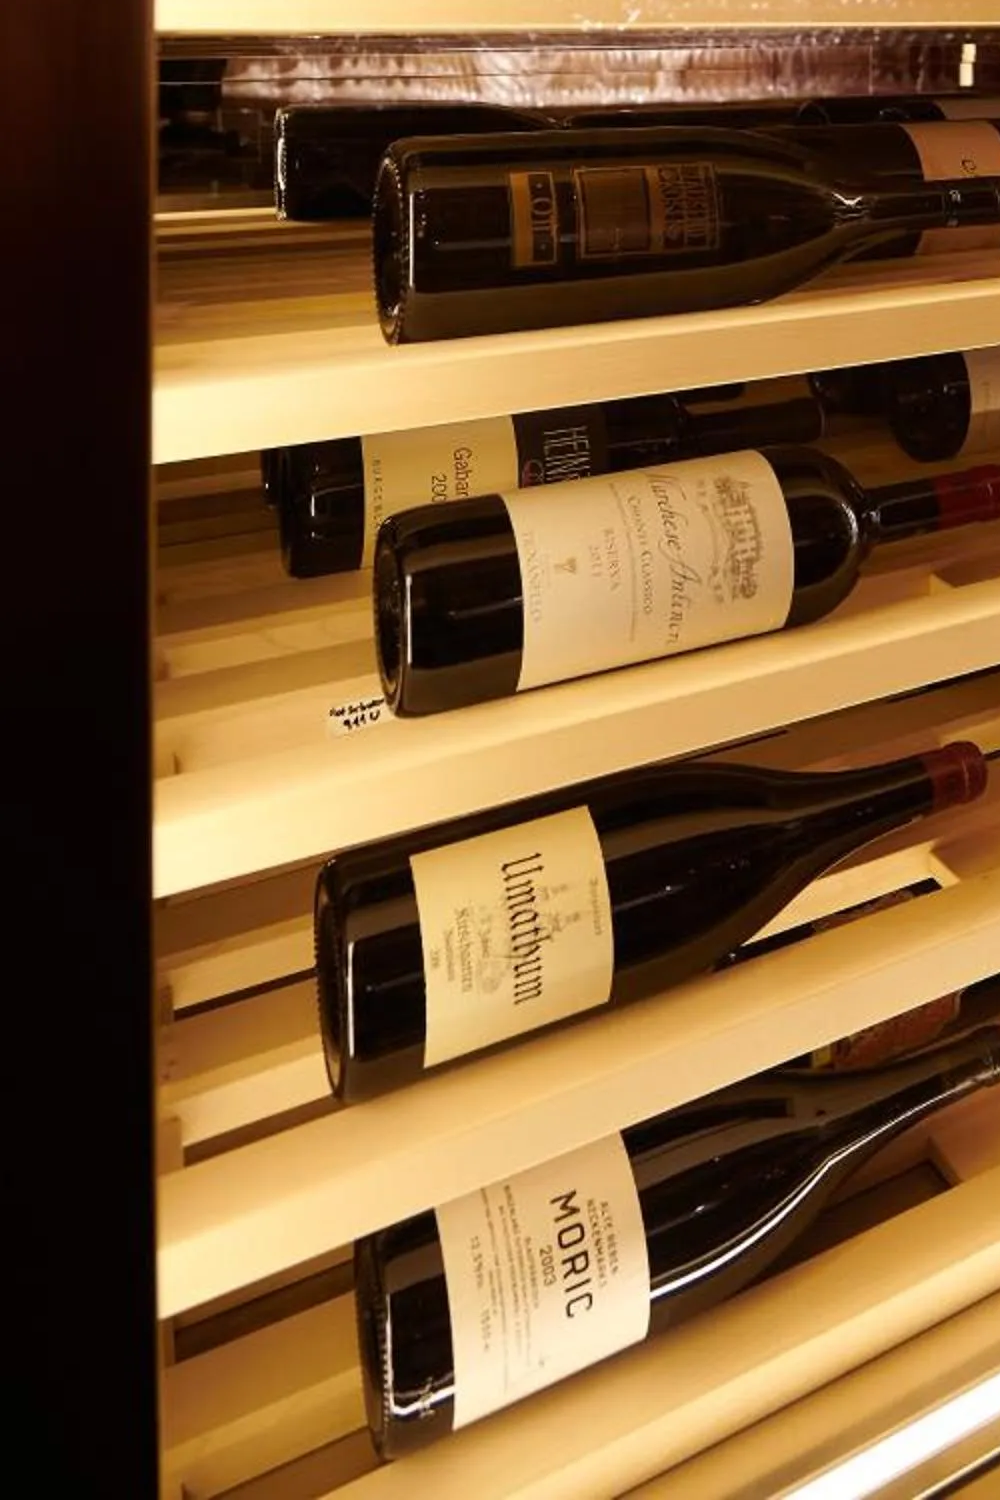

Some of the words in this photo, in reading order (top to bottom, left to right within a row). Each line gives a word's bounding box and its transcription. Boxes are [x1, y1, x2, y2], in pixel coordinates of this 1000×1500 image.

[453, 447, 472, 496] Gabar
[544, 426, 590, 480] HEIN
[501, 852, 544, 1005] Umathum
[539, 1244, 558, 1287] 2003
[550, 1189, 593, 1318] MORIC
